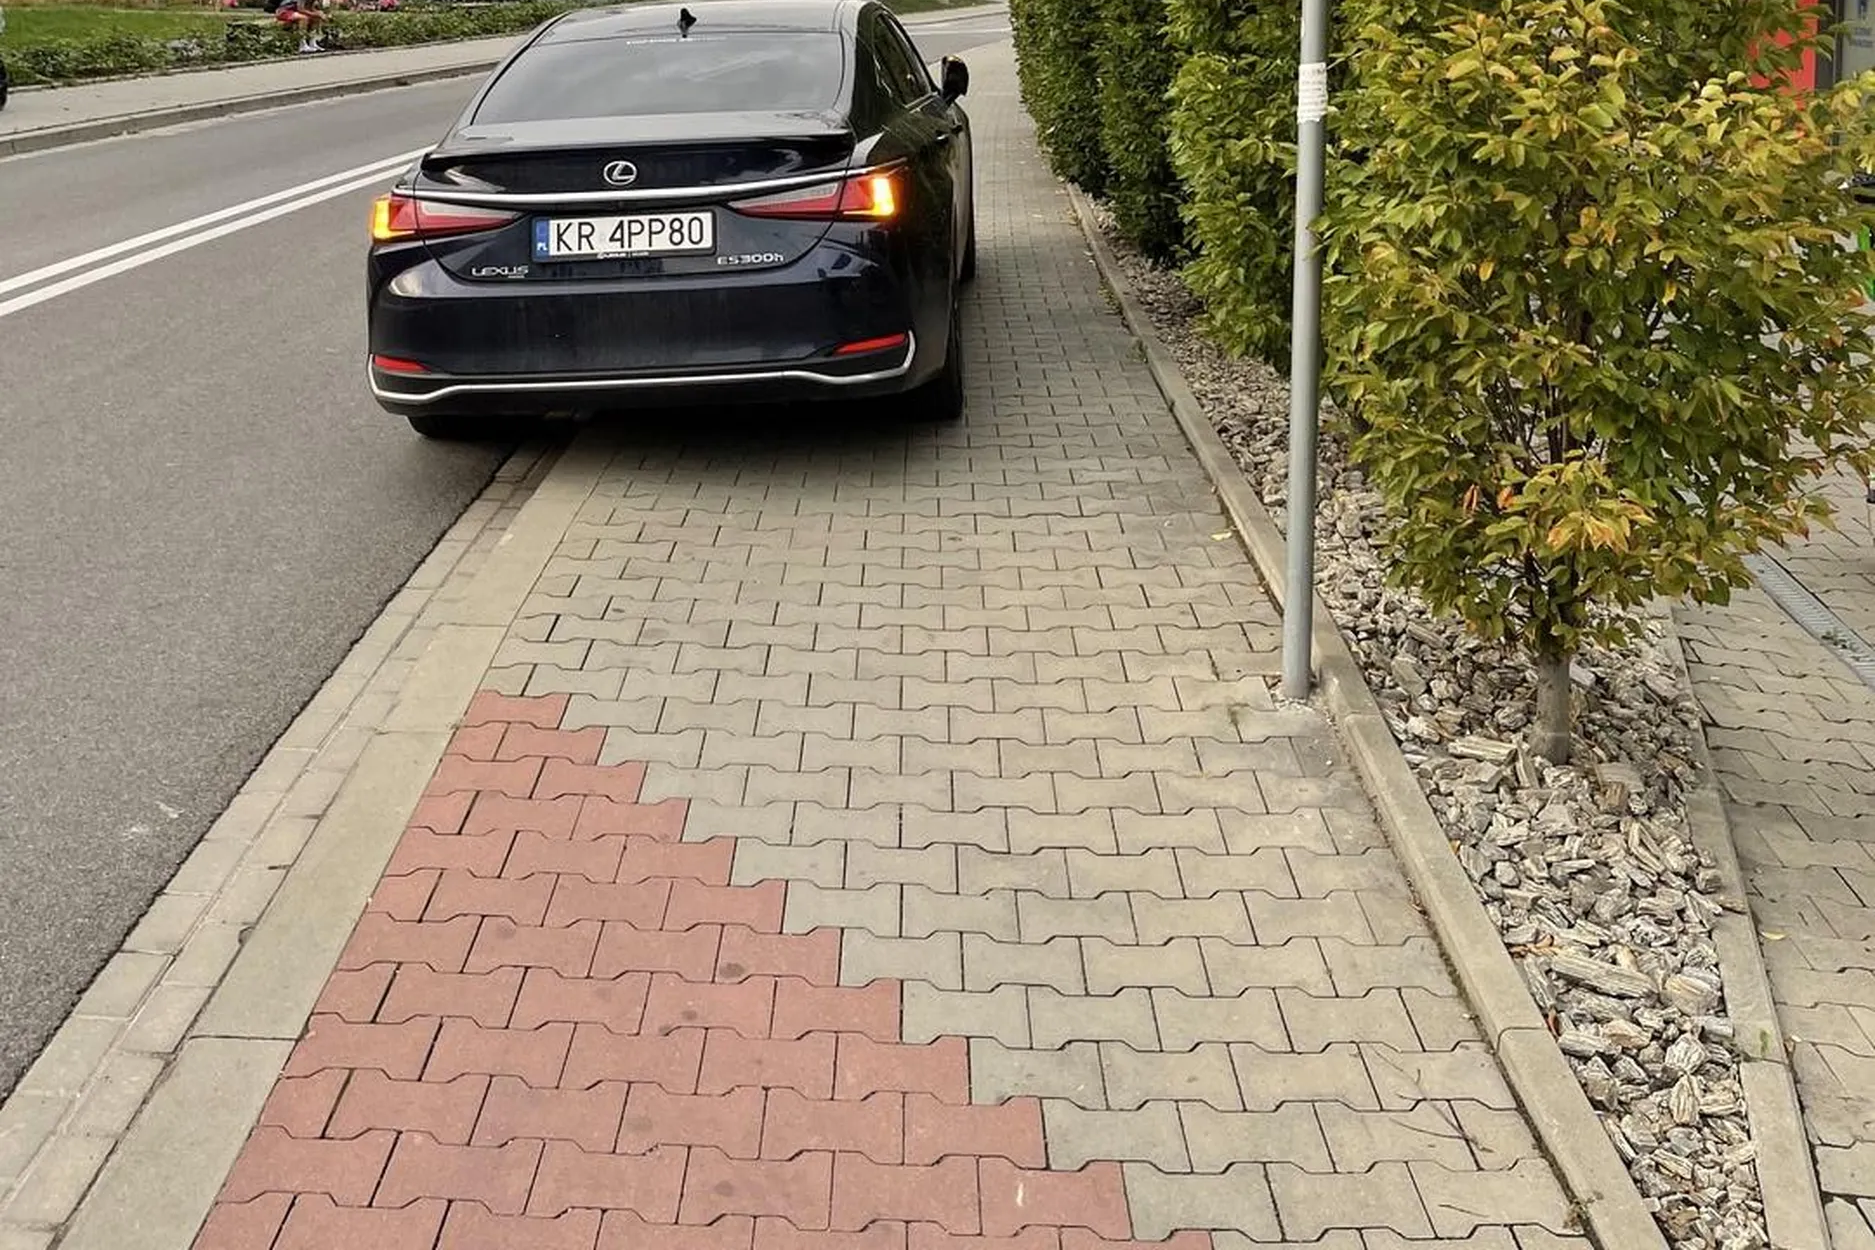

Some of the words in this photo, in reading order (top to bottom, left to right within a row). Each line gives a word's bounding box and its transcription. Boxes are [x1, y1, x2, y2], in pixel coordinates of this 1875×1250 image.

[556, 222, 595, 251] KR
[609, 217, 704, 248] 4PP80
[472, 265, 529, 276] LEXUS
